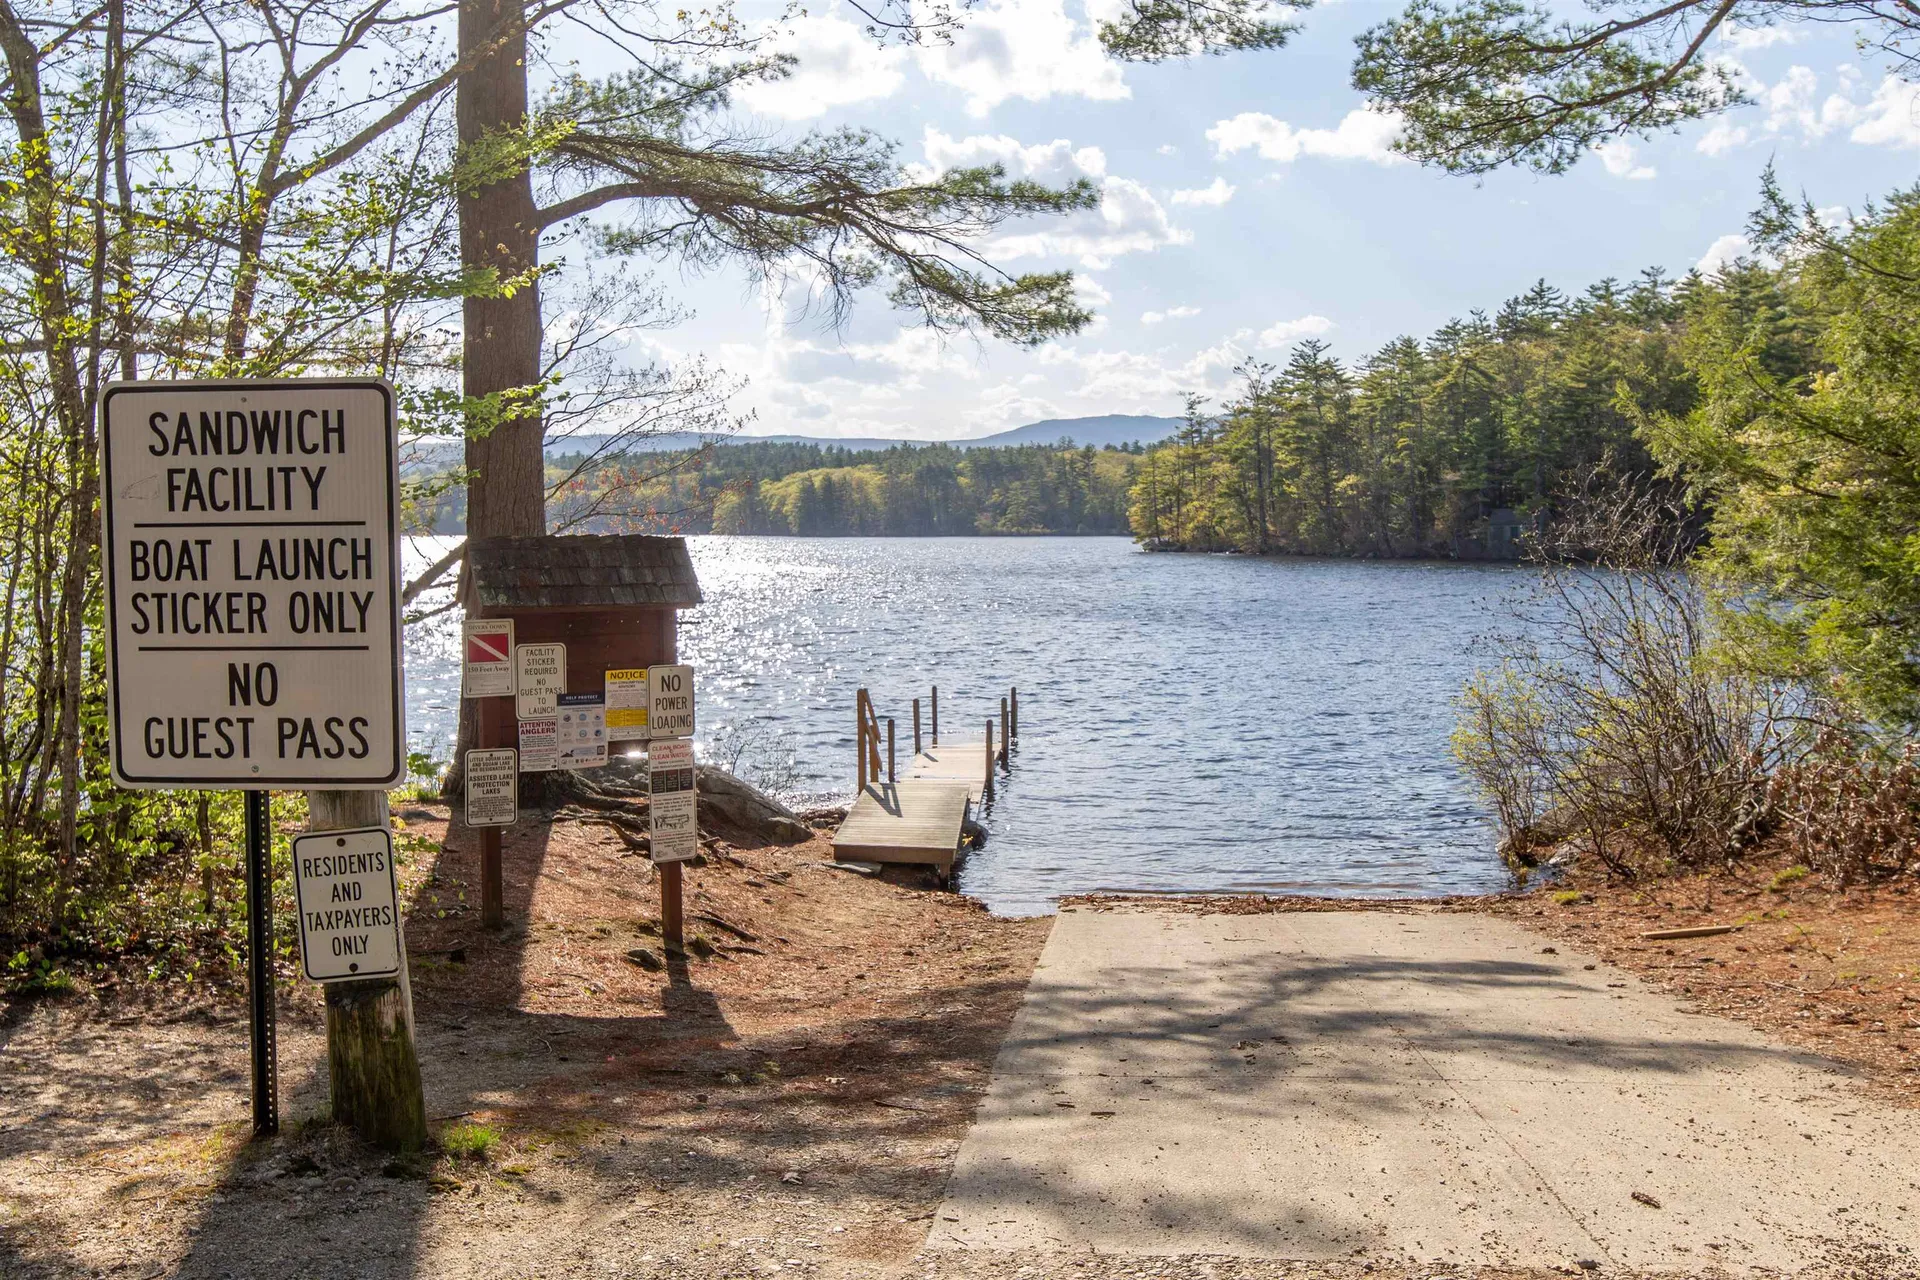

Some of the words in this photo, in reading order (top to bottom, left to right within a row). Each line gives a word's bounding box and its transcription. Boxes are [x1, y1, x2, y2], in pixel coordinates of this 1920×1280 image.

[148, 409, 345, 456] SANDWICH
[167, 466, 327, 512] FACILITY
[130, 539, 212, 582] BOAT
[234, 537, 372, 581] LAUNCH
[131, 592, 267, 634] STICKER
[289, 591, 374, 634] ONLY
[525, 648, 555, 656] FACILITY
[526, 658, 555, 666] STICKER
[493, 665, 509, 673] Away
[525, 667, 558, 675] REQUIRED
[610, 671, 644, 679] NOTICE
[229, 662, 278, 707] NO
[536, 678, 546, 686] NO
[661, 674, 681, 692] NO
[520, 688, 542, 696] GUEST
[537, 697, 546, 705] TO
[655, 696, 687, 711] POWER
[528, 706, 555, 715] LAUNCH
[520, 721, 556, 729] ATTENTION
[652, 714, 692, 730] LOADING
[520, 727, 556, 735] ANGLERS
[144, 717, 255, 760] GUEST
[278, 716, 370, 760] PASS
[469, 774, 498, 782] ASSISTED
[472, 780, 510, 789] PROTECTION
[303, 852, 385, 878] RESIDENTS
[331, 881, 362, 903] AND
[306, 905, 392, 932] TAXPAYERS
[332, 934, 369, 956] ONLY
